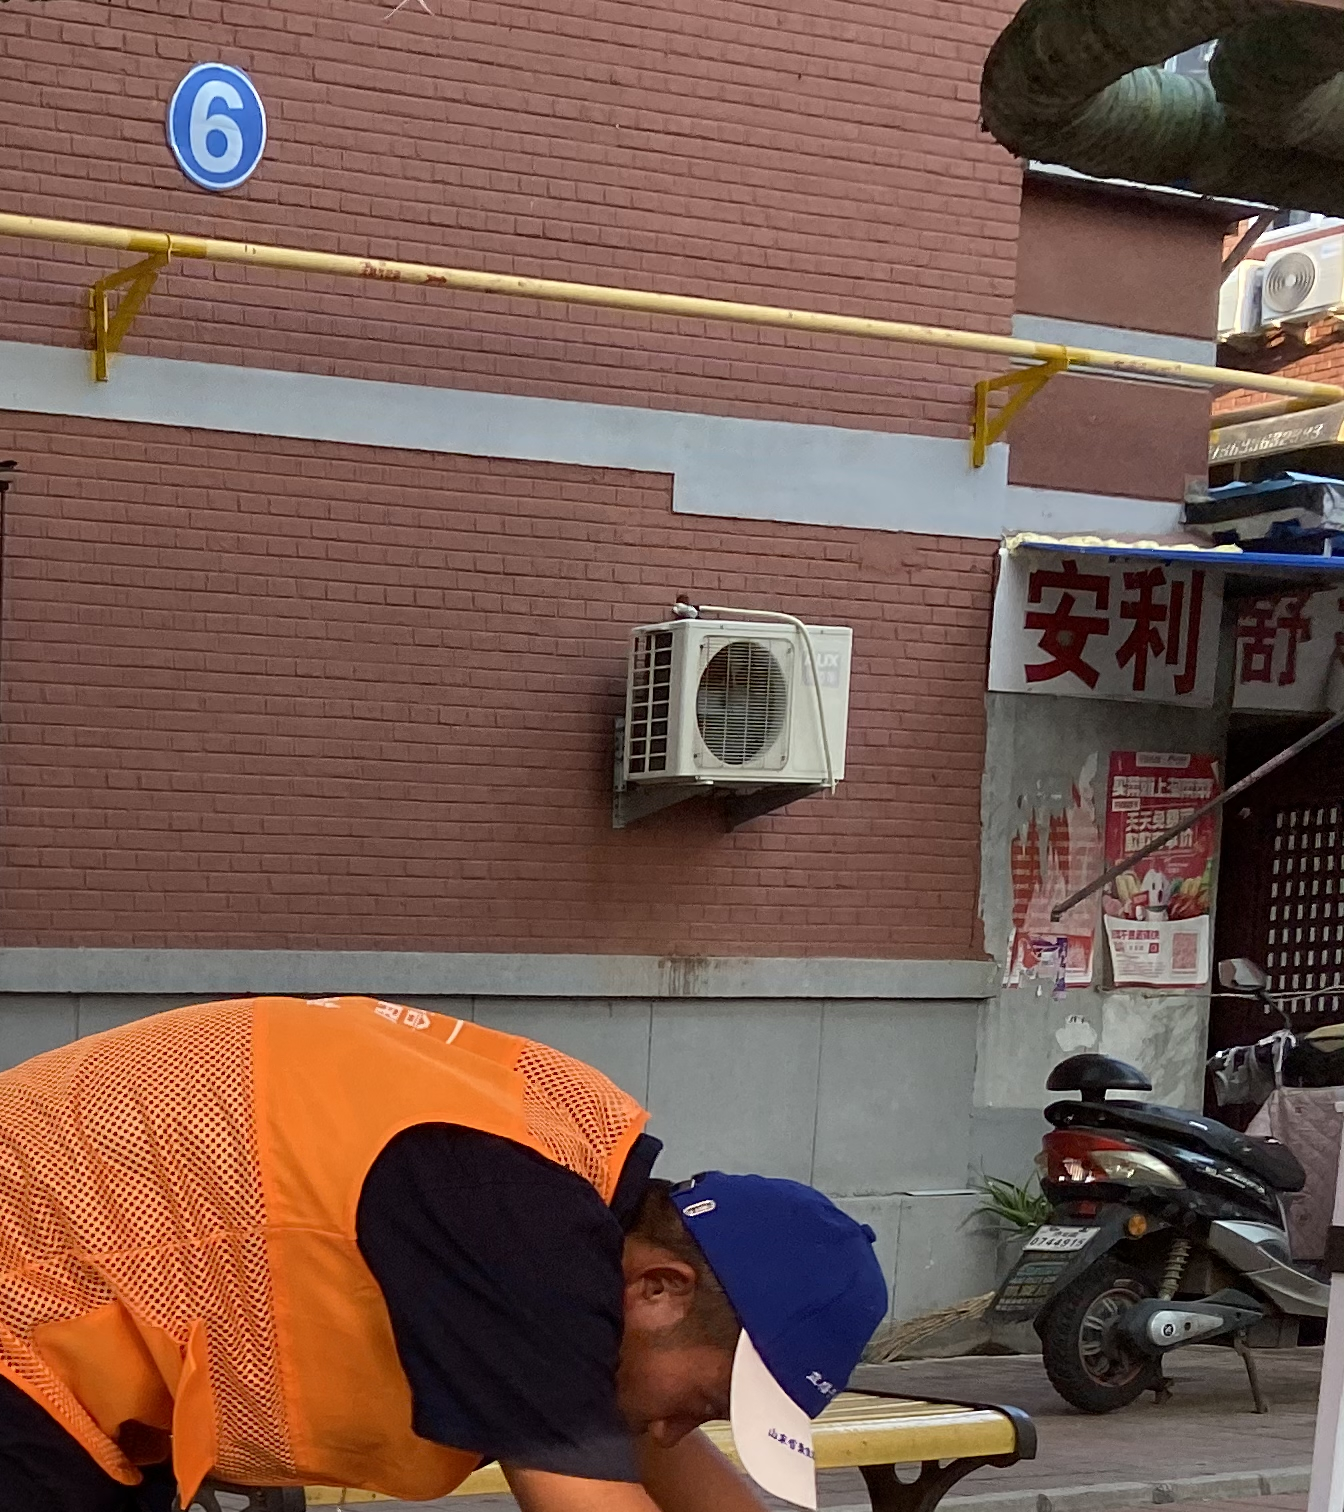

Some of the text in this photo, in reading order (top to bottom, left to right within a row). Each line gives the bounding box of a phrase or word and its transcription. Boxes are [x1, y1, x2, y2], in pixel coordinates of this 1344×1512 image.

[190, 80, 244, 173] 6
[1023, 559, 1205, 695] 安利
[1235, 597, 1344, 686] 舒
